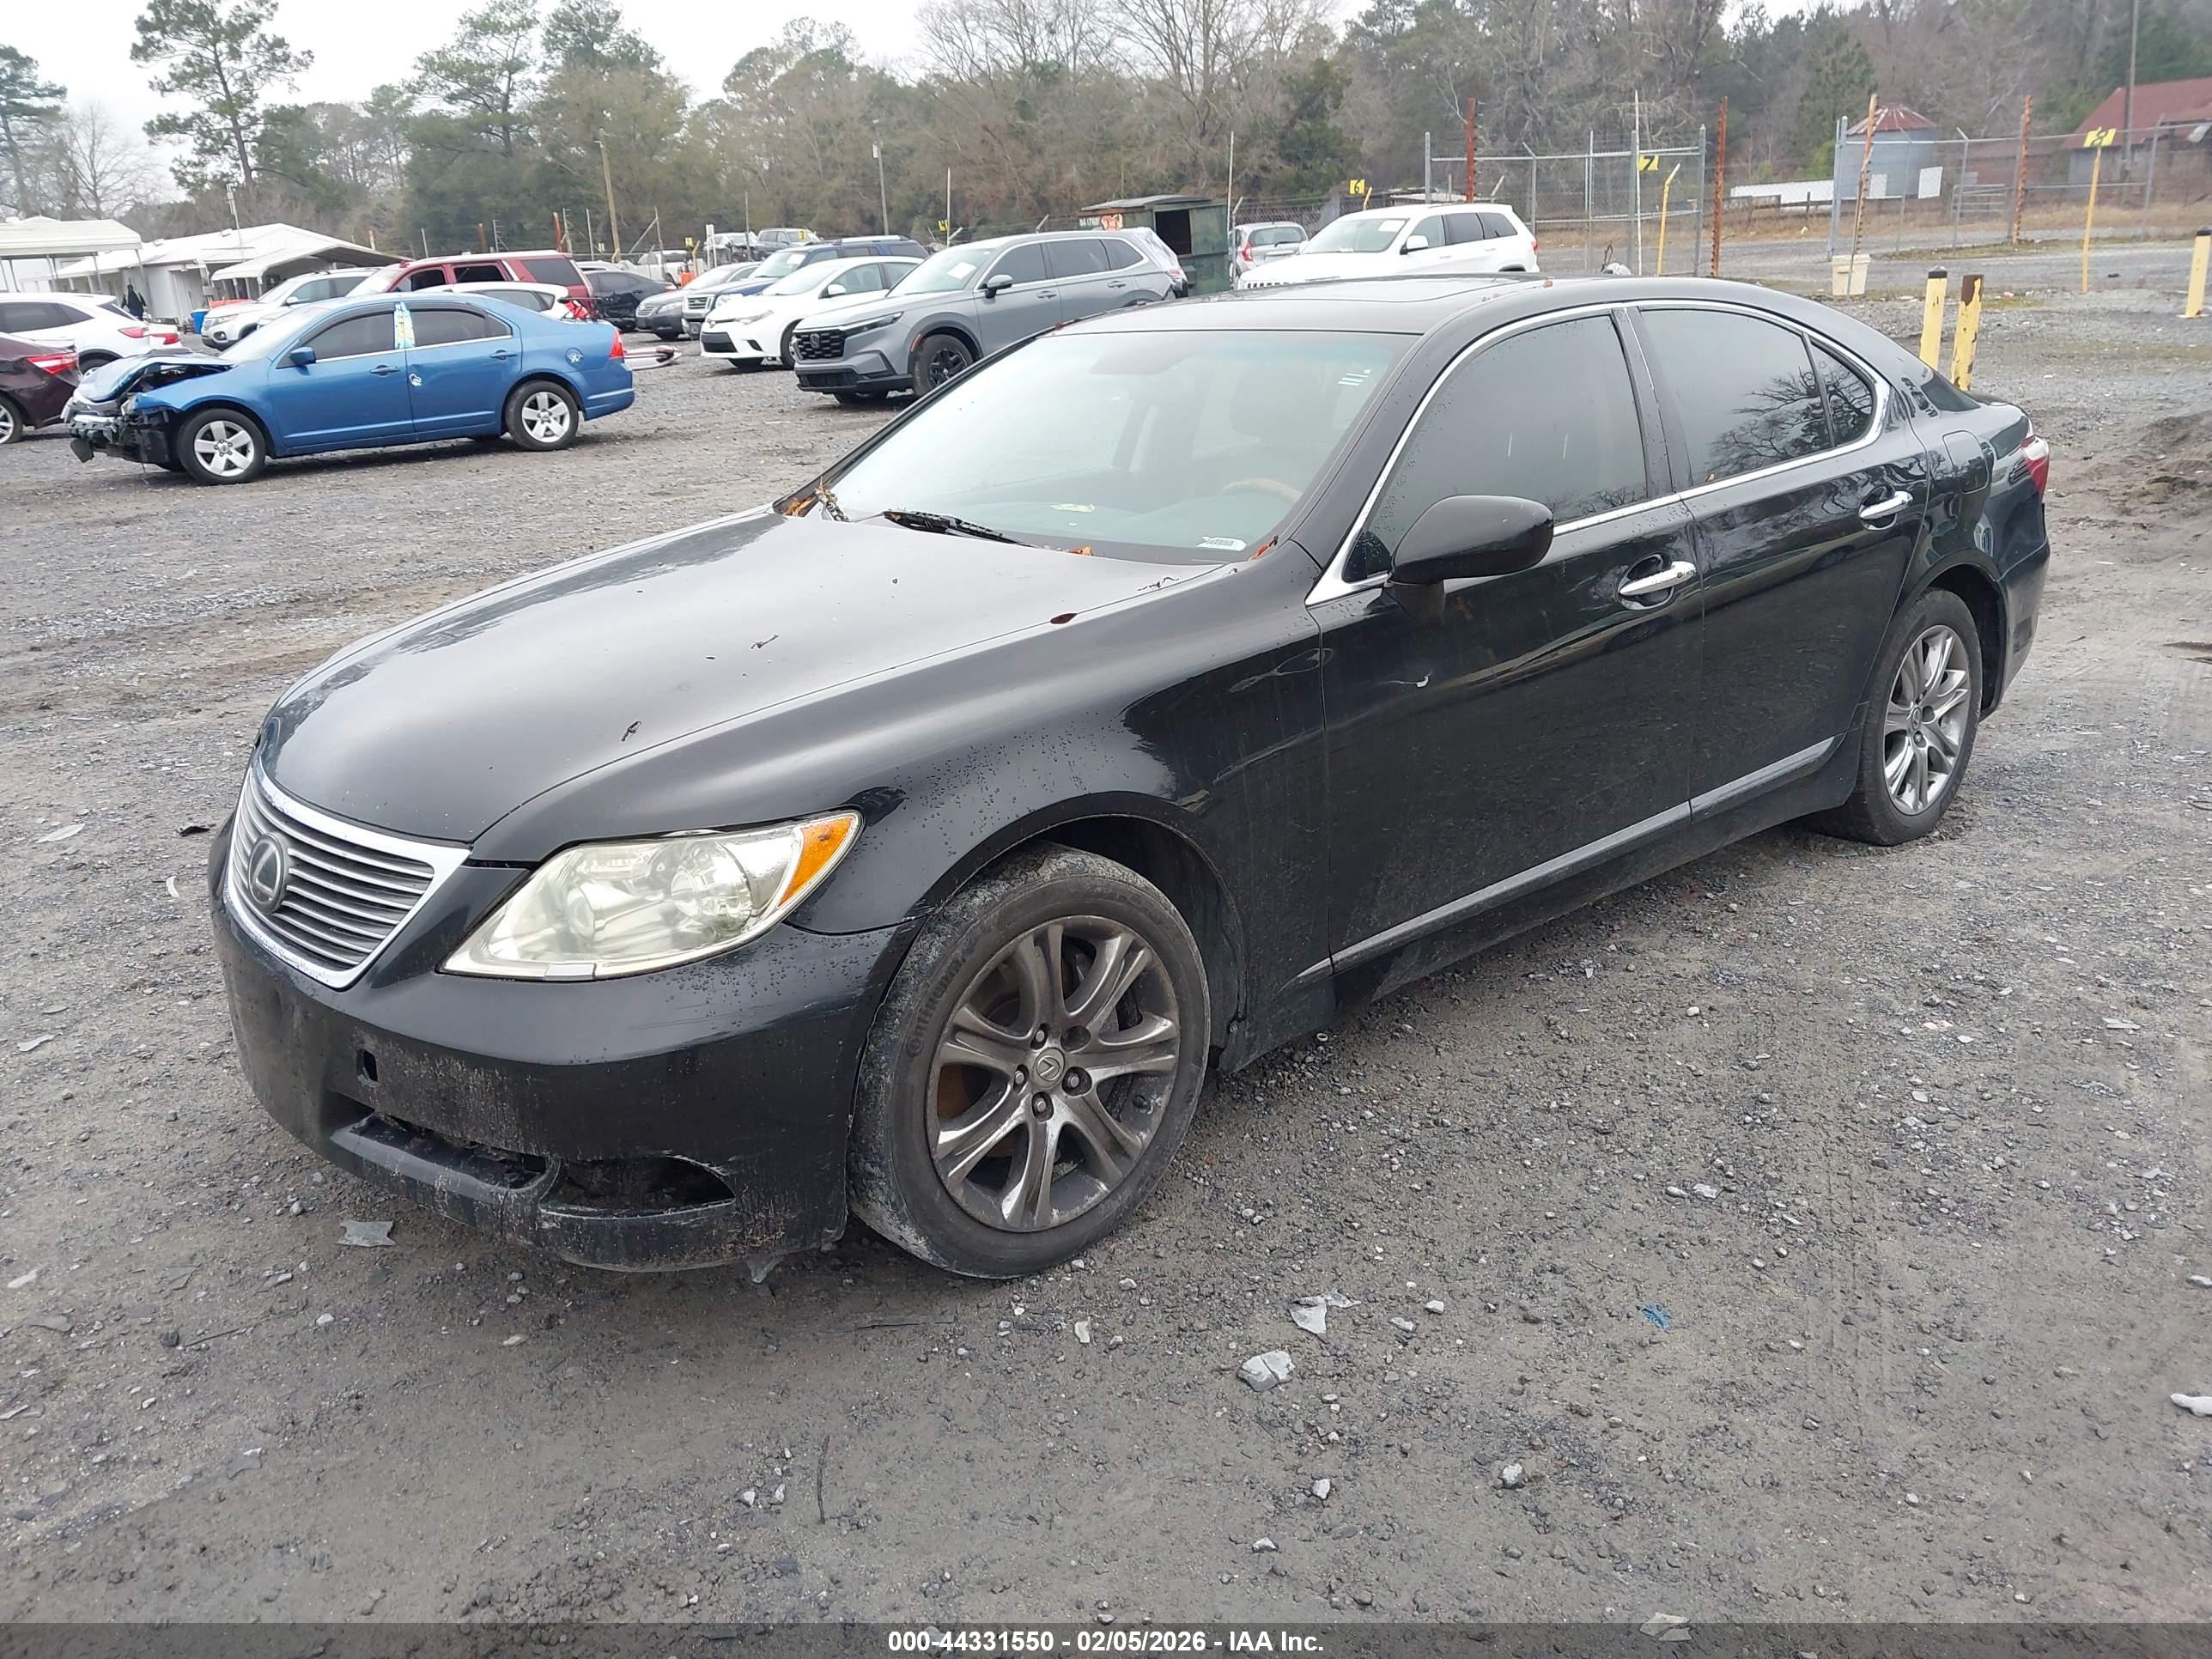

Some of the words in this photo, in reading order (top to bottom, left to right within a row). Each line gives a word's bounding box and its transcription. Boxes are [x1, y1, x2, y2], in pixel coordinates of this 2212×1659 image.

[2090, 130, 2108, 146] 8
[1642, 155, 1655, 172] 7
[1354, 179, 1360, 194] 6
